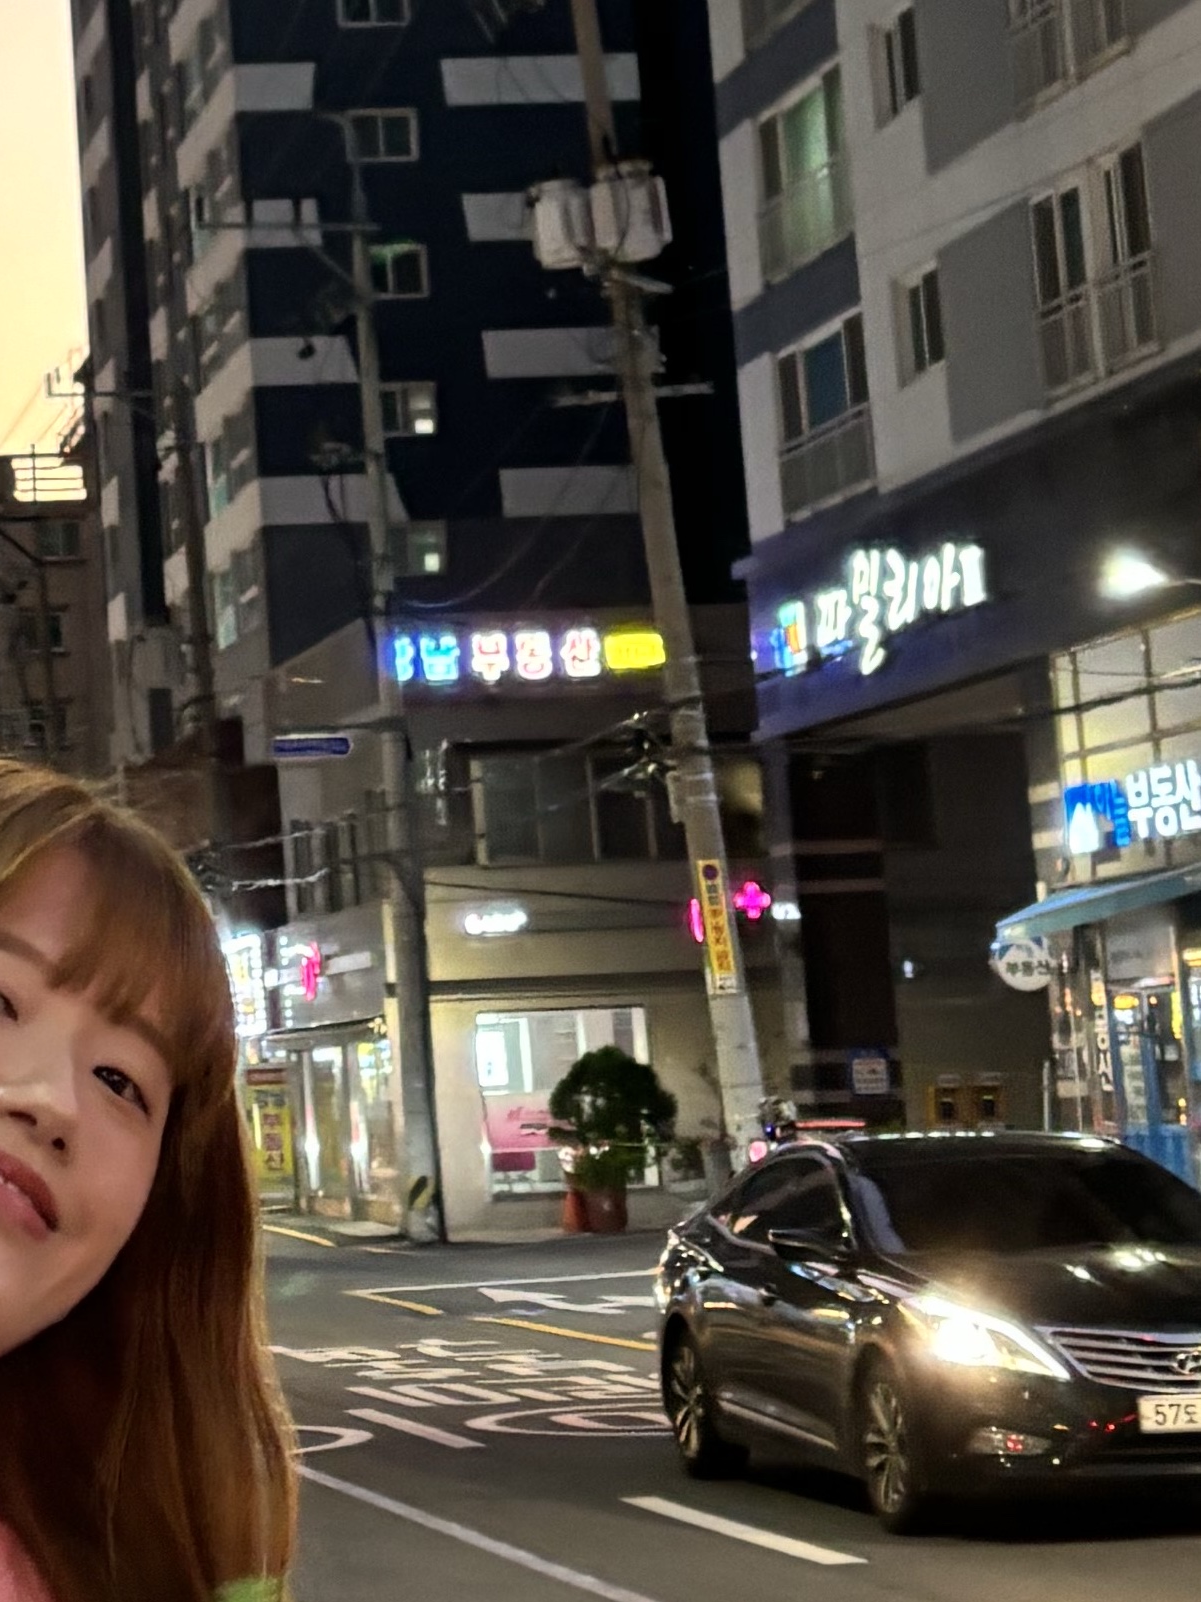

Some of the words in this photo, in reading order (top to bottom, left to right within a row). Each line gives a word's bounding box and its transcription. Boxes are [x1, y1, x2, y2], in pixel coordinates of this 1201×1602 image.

[816, 543, 961, 675] 파밀리아
[471, 627, 602, 681] 부동산
[1004, 959, 1052, 977] 부동산
